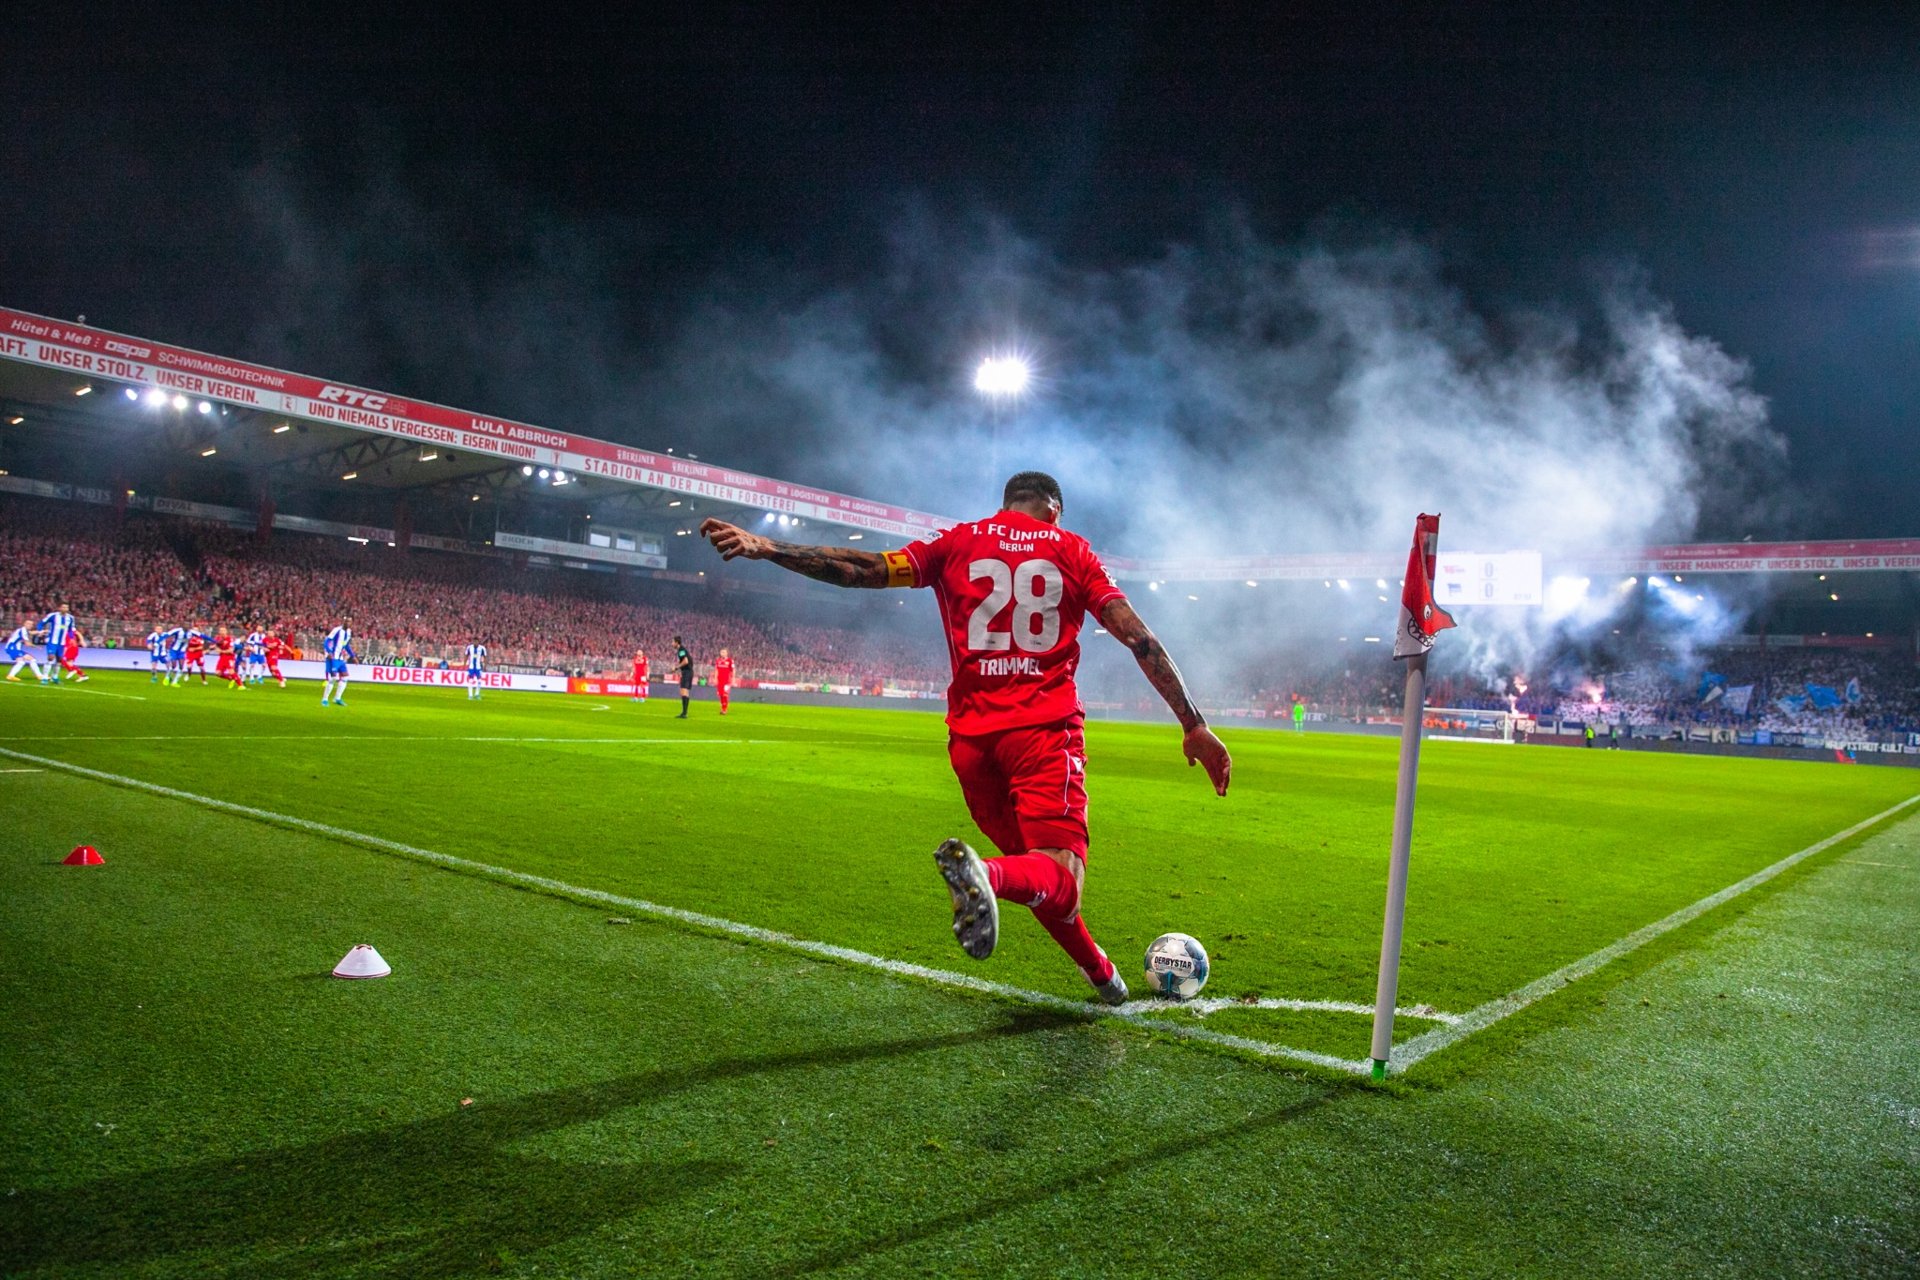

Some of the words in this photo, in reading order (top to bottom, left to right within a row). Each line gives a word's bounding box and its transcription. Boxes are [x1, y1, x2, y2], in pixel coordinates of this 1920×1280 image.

[11, 319, 48, 336] Hütel
[51, 329, 61, 339] &
[39, 345, 92, 370] UNSER
[97, 358, 148, 381] STOLZ.
[156, 370, 203, 393] UNSER
[207, 380, 259, 404] VEREIN.
[158, 351, 286, 387] SCHWIMMBADTECHNIK
[318, 385, 388, 411] RTC
[309, 402, 335, 419] UND
[338, 408, 389, 430] NIEMALS
[392, 418, 458, 444] VERGESSEN:
[462, 433, 498, 452] EISERN
[501, 441, 536, 460] UNION!
[471, 418, 505, 435] LULA
[507, 427, 568, 448] ABBRUCH
[584, 458, 642, 481] STADION
[647, 471, 665, 486] AN
[670, 475, 692, 491] DER
[697, 482, 733, 499] ALTEN
[971, 524, 983, 535] 1.
[988, 523, 1006, 537] FC
[1009, 528, 1060, 542] UNION
[999, 540, 1034, 552] BERLIN
[1656, 561, 1692, 571] UNSERE
[1696, 560, 1764, 571] MANNSCHAFT.
[1768, 560, 1801, 569] UNSER
[1803, 559, 1839, 569] STOLZ.
[1842, 558, 1880, 568] UNSER
[968, 558, 1063, 653] 28
[357, 653, 417, 667] FRONTLNE
[978, 656, 1043, 676] TRIMMEL
[373, 667, 434, 683] RUDER
[1154, 956, 1192, 969] DERBYSTAR
